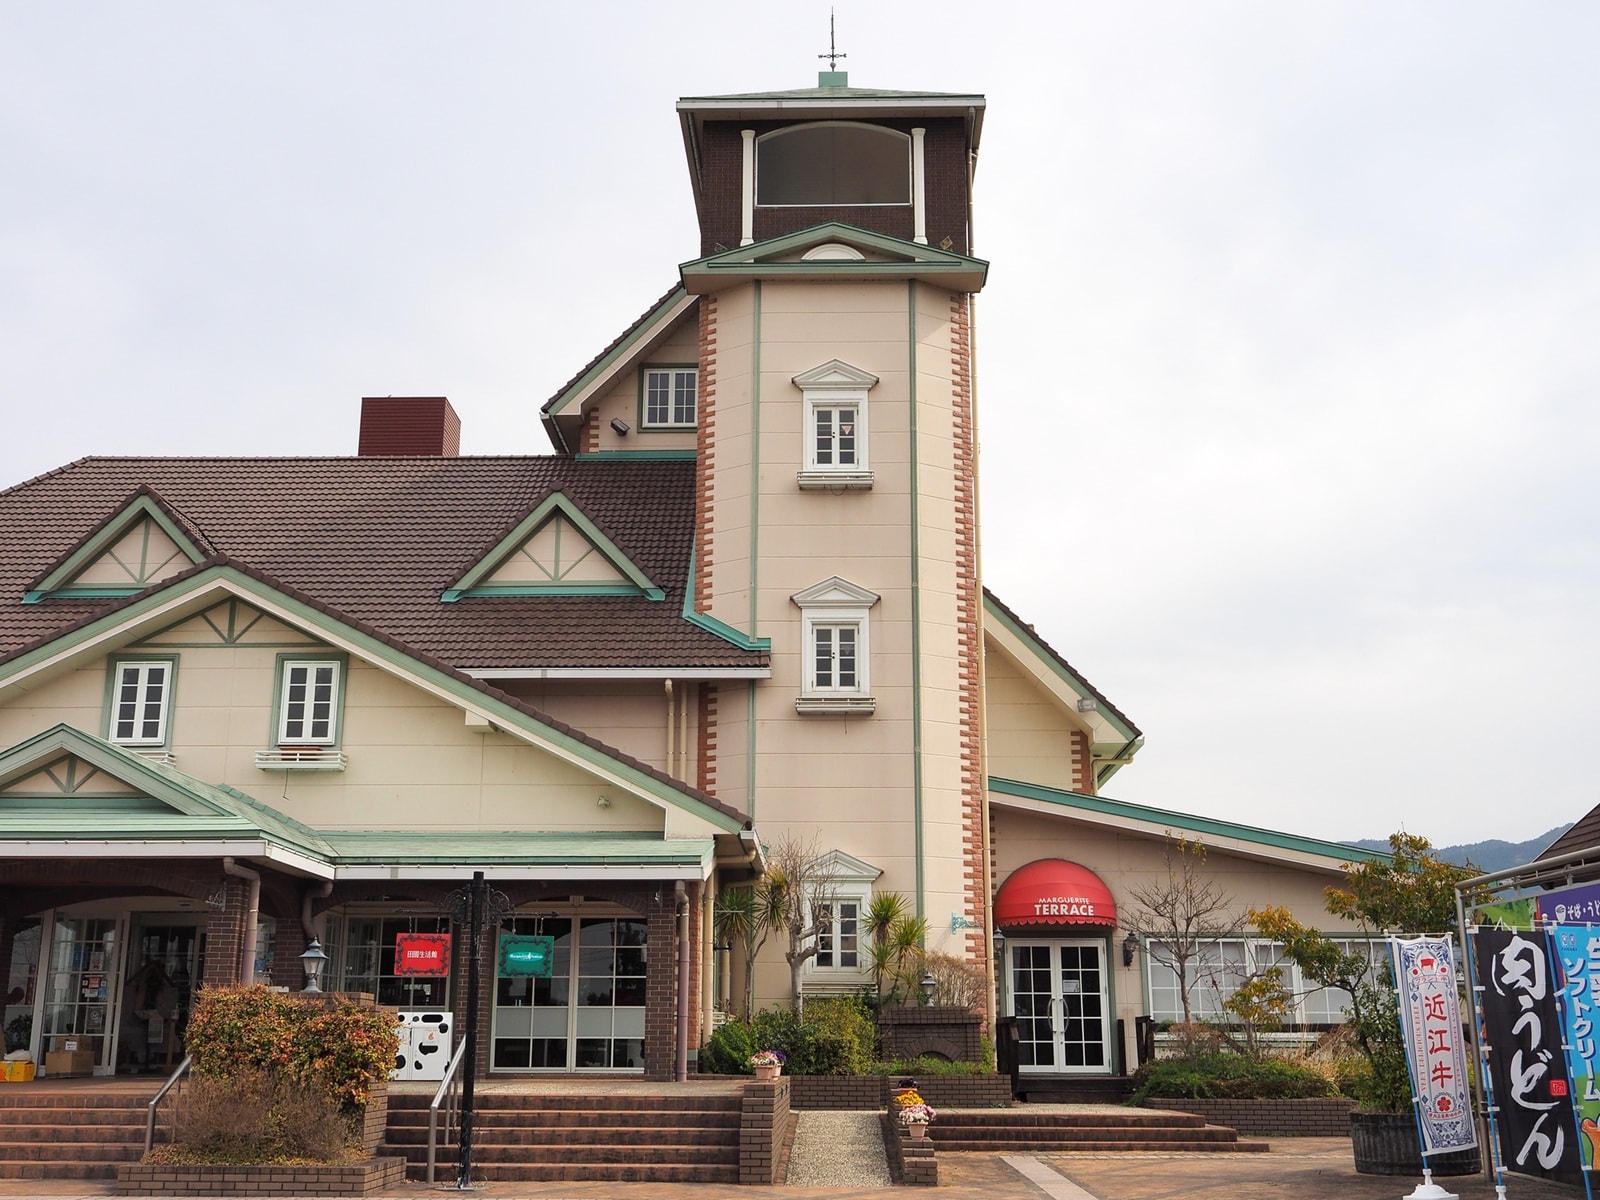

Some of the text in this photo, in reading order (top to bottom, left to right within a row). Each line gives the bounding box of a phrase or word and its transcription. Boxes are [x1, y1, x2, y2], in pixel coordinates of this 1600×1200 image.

[1034, 904, 1094, 916] TERRACE
[1038, 897, 1090, 905] MARGUERITE
[1425, 993, 1454, 1089] 近江牛
[1490, 935, 1565, 1170] 肉うどん
[1564, 957, 1600, 1101] ソフトクリーム
